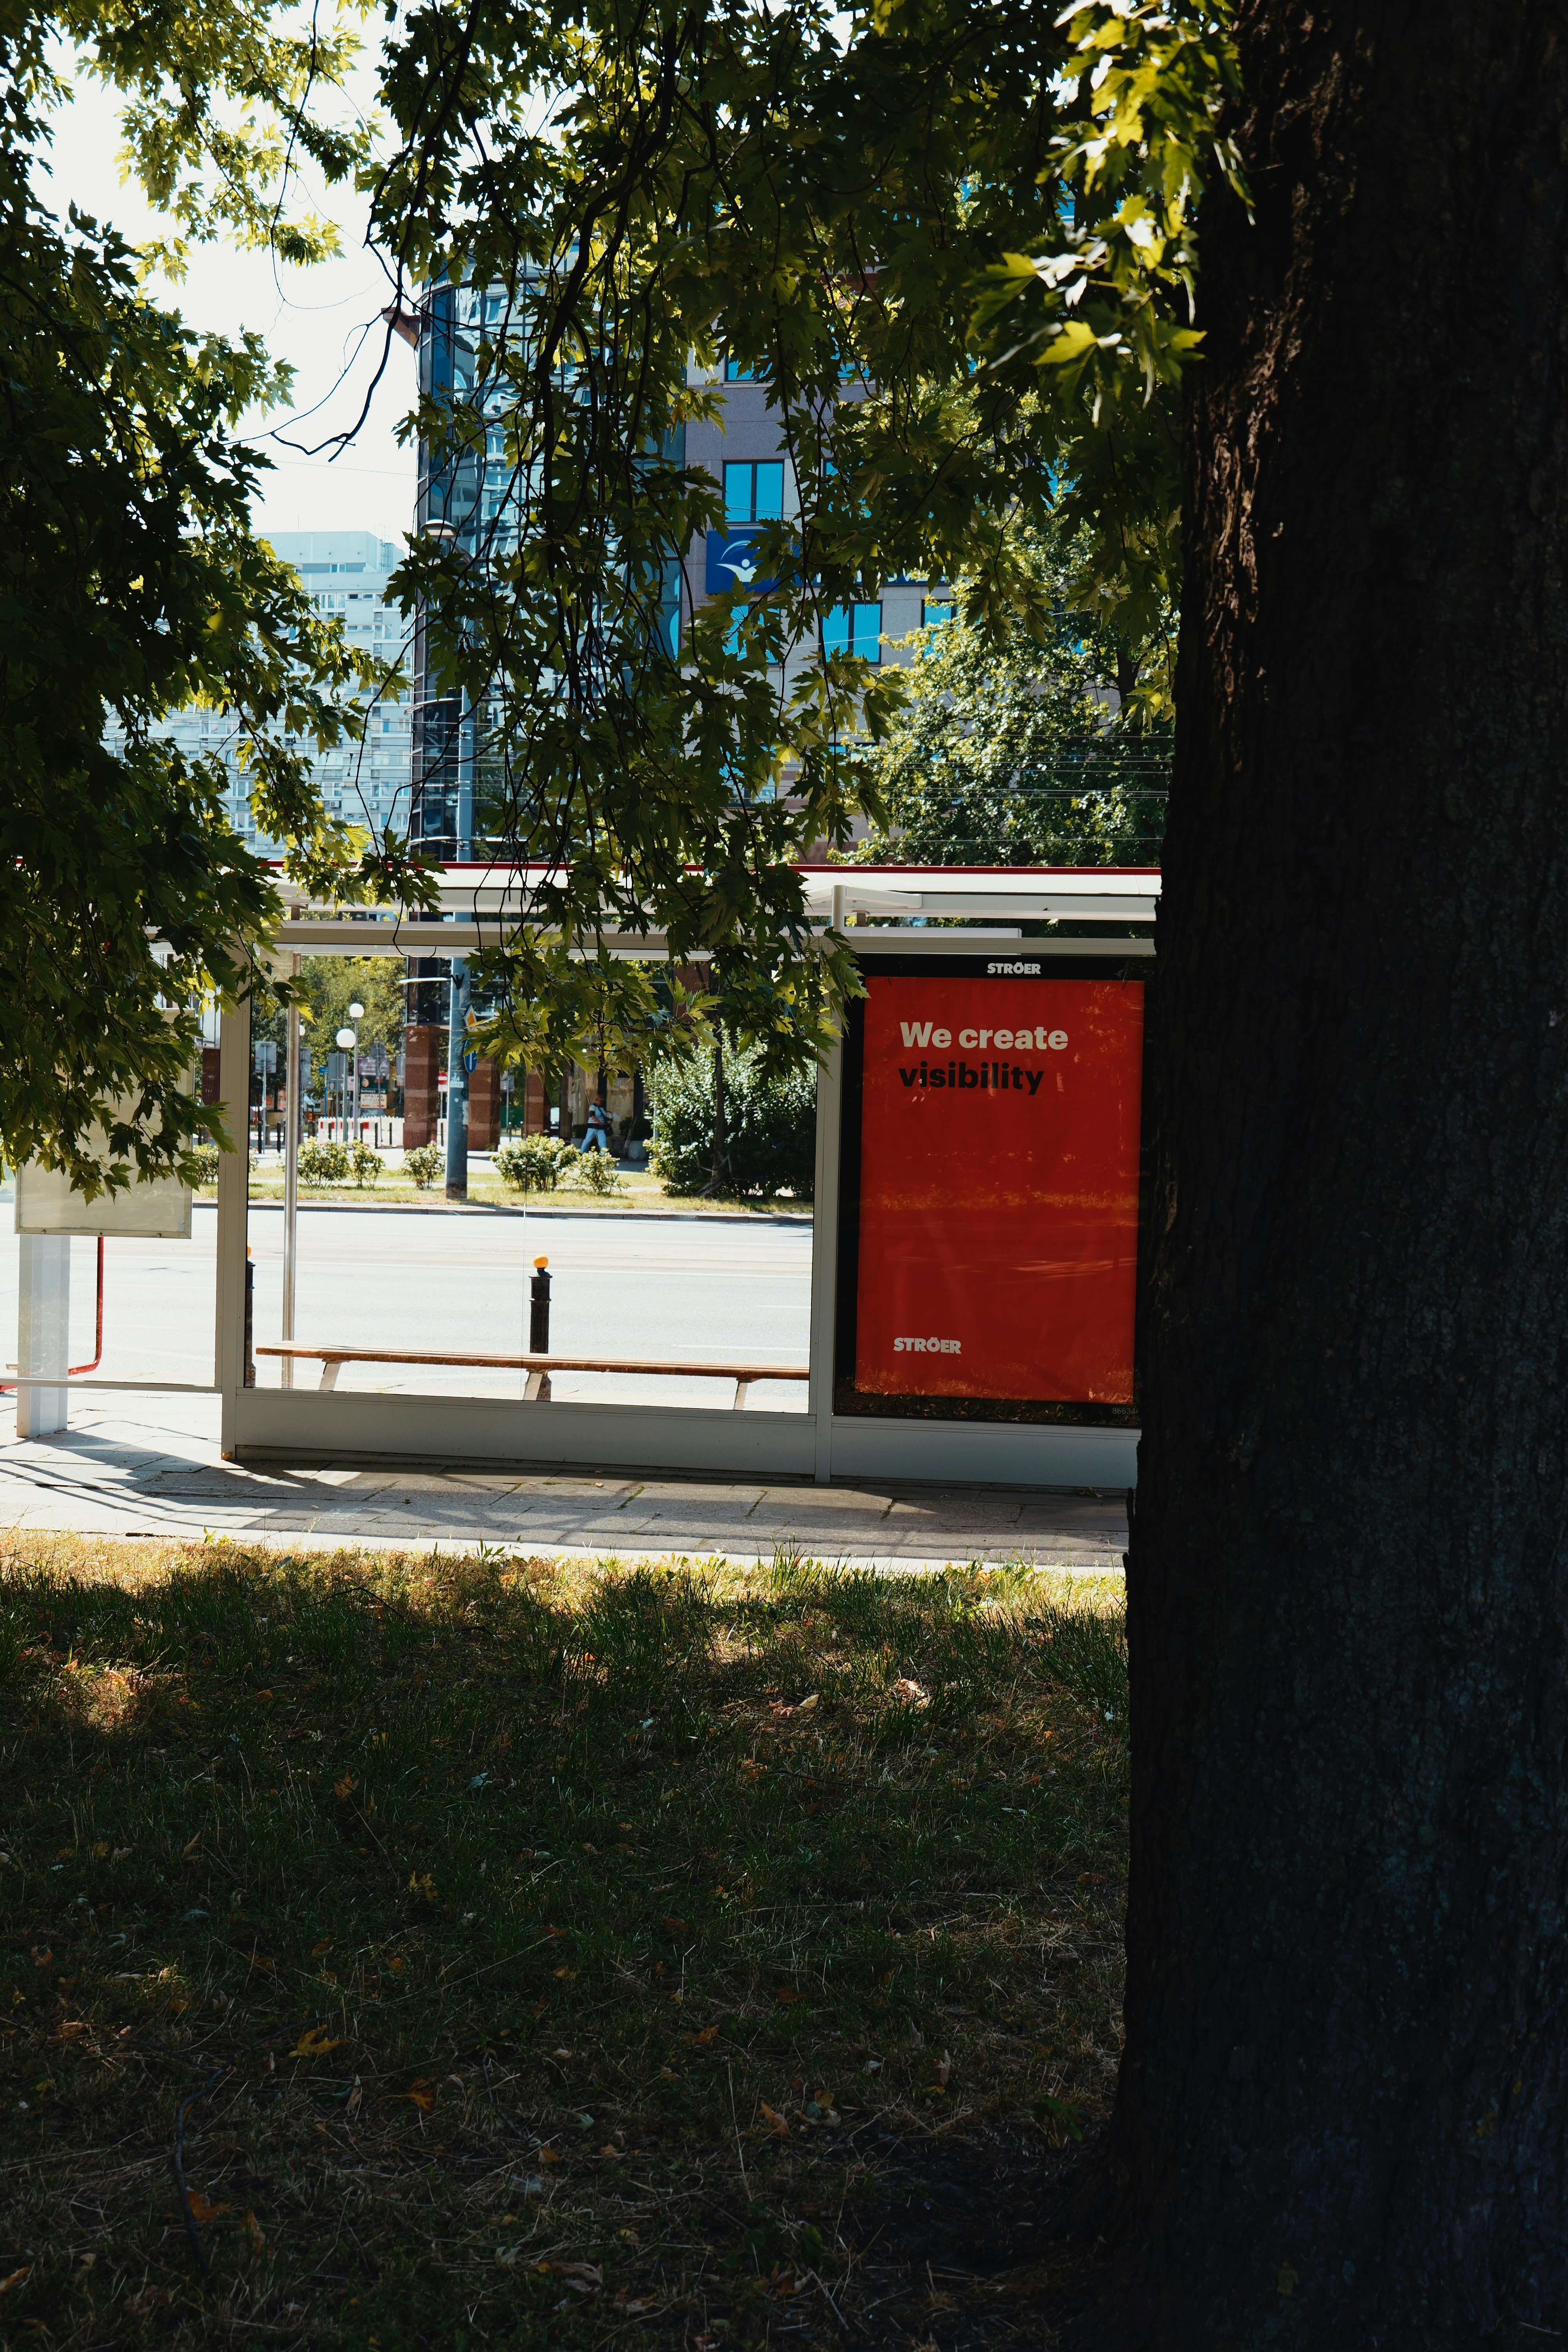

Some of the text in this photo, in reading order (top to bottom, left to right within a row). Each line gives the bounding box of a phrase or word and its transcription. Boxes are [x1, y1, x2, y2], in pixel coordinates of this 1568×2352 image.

[987, 962, 1041, 974] STRÖER
[900, 1022, 1068, 1050] We create
[898, 1061, 1044, 1095] visibility
[893, 1337, 962, 1354] STRÖER
